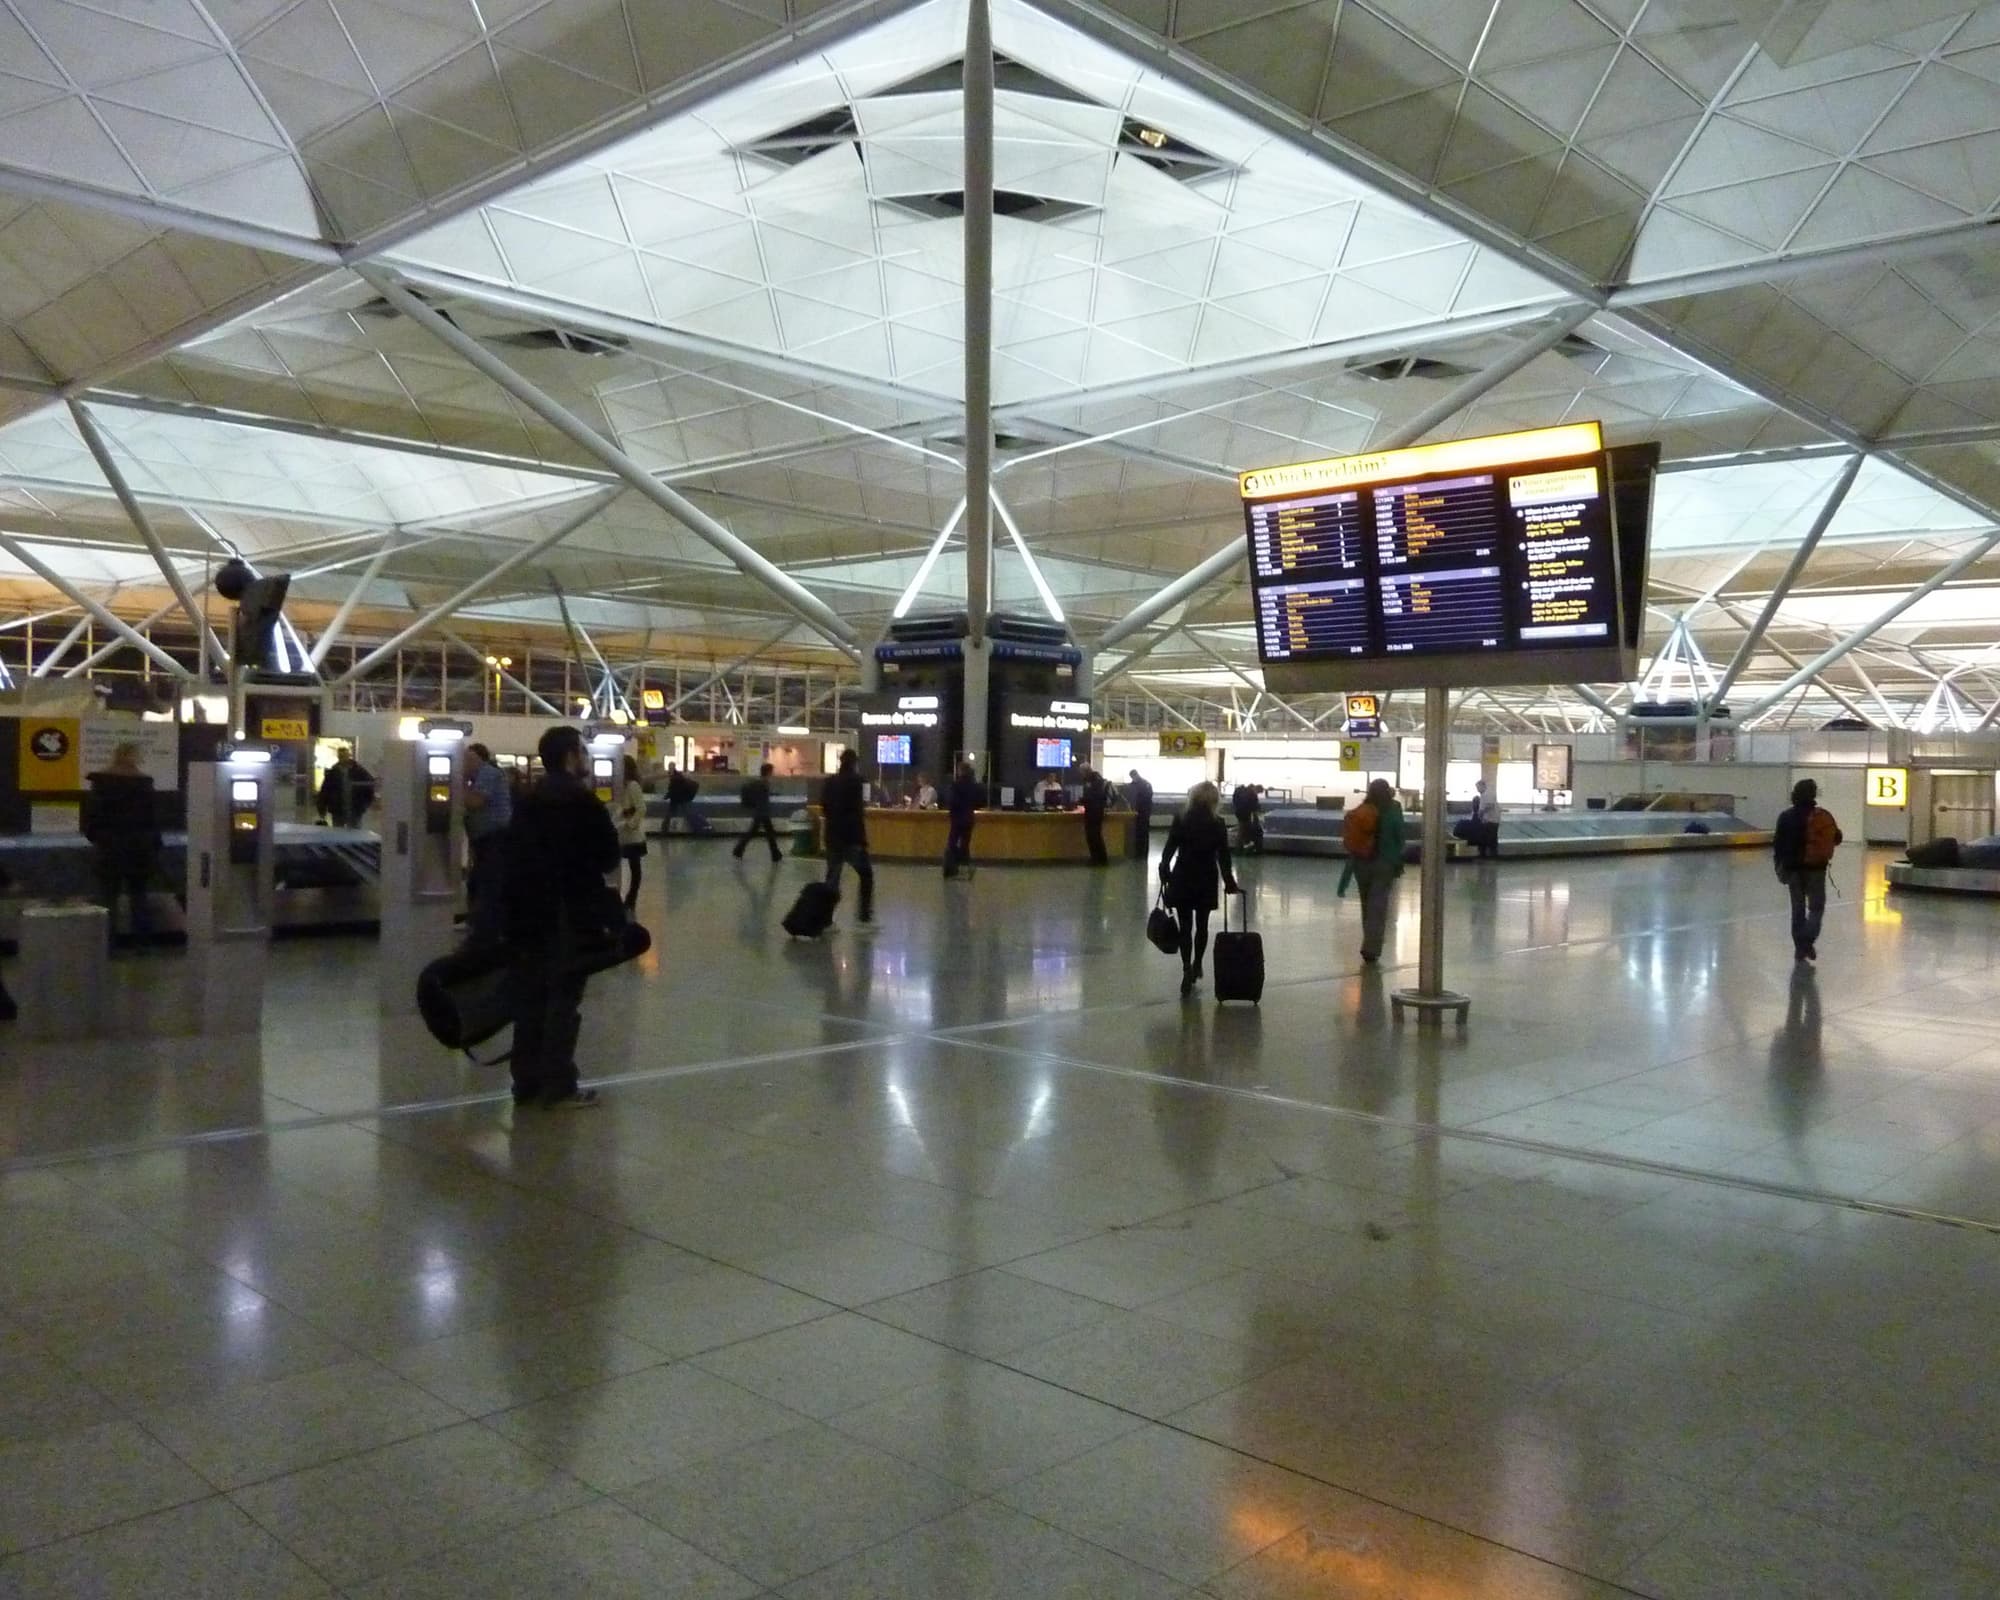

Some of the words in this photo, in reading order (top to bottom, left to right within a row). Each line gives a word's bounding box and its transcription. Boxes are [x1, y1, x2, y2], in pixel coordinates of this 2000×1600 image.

[1262, 469, 1313, 487] Which
[1319, 457, 1388, 477] reclaim?
[862, 712, 892, 725] Bureau
[892, 711, 904, 725] de
[904, 711, 938, 728] Change
[1011, 713, 1044, 727] Bureau
[1044, 714, 1056, 728] de
[1056, 715, 1089, 732] Change
[1878, 776, 1898, 798] B
